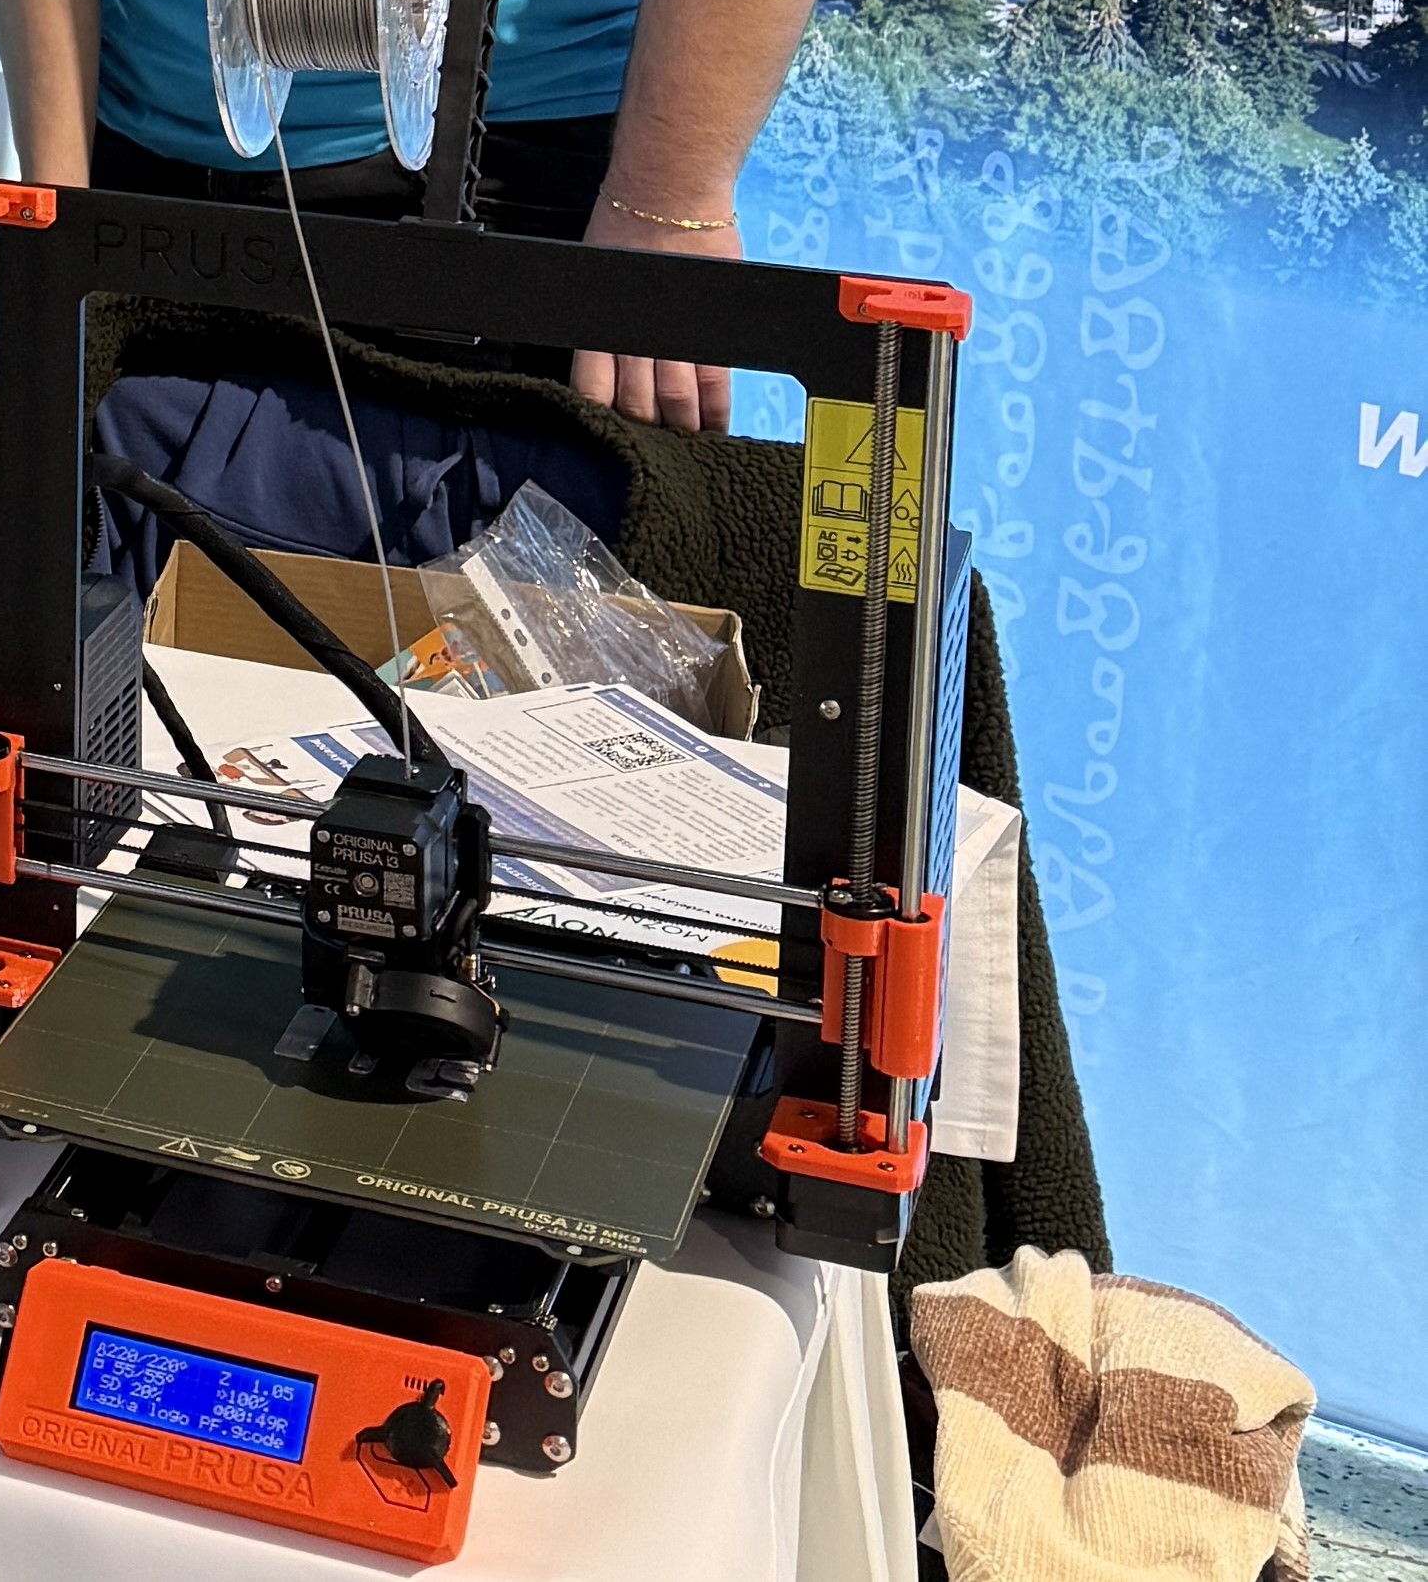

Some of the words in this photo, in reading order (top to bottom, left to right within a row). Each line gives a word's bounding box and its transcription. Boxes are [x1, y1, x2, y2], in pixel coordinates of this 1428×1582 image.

[818, 530, 838, 542] AC
[332, 846, 384, 866] PRUSA
[333, 833, 399, 854] ORIGINAL
[337, 904, 394, 924] PRUSA
[356, 1174, 476, 1211] ORIGINAL
[482, 1201, 568, 1229] PRUSA
[602, 1229, 642, 1244] MK3
[524, 1222, 545, 1232] by
[547, 1227, 596, 1242] Josef
[599, 1238, 648, 1254] Prusa
[99, 1374, 121, 1391] SD
[130, 1382, 162, 1402] 20%
[219, 1371, 232, 1386] Z
[252, 1379, 294, 1402] 1.05
[86, 1387, 139, 1413] kazka
[149, 1402, 190, 1426] logo
[199, 1415, 285, 1449] PF.gcode
[22, 1415, 153, 1468] ORIGINAL
[161, 1440, 316, 1508] PRUSA
